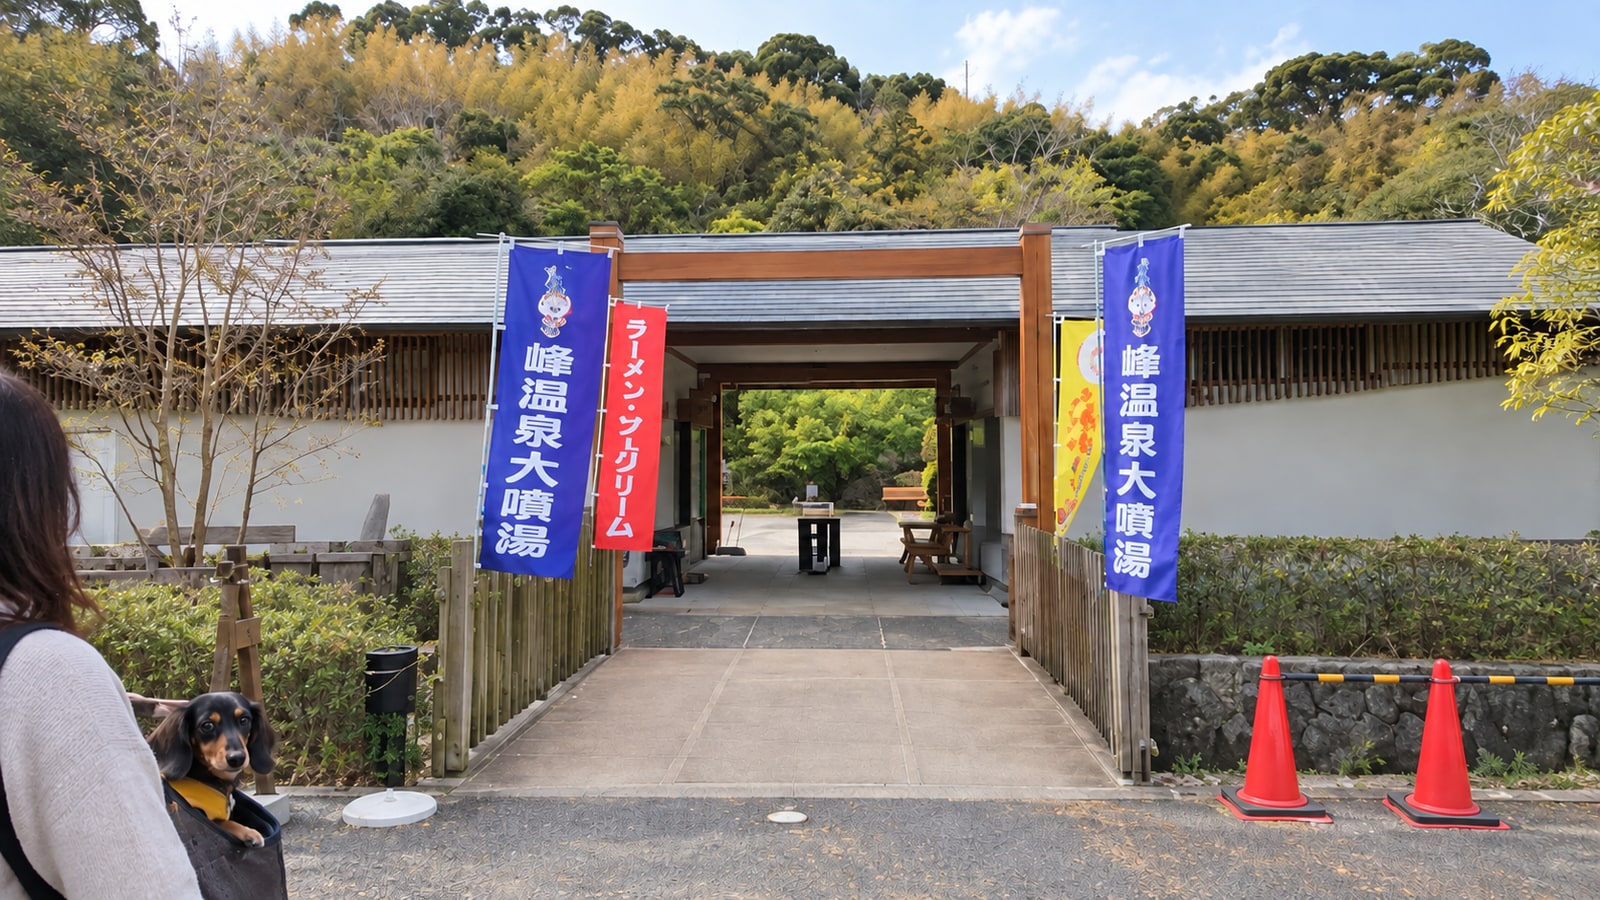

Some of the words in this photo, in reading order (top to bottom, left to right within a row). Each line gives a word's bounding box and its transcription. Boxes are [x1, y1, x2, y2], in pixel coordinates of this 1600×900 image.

[495, 342, 575, 558] 峰温泉大噴湯
[1113, 343, 1161, 579] 峰温泉大噴湯
